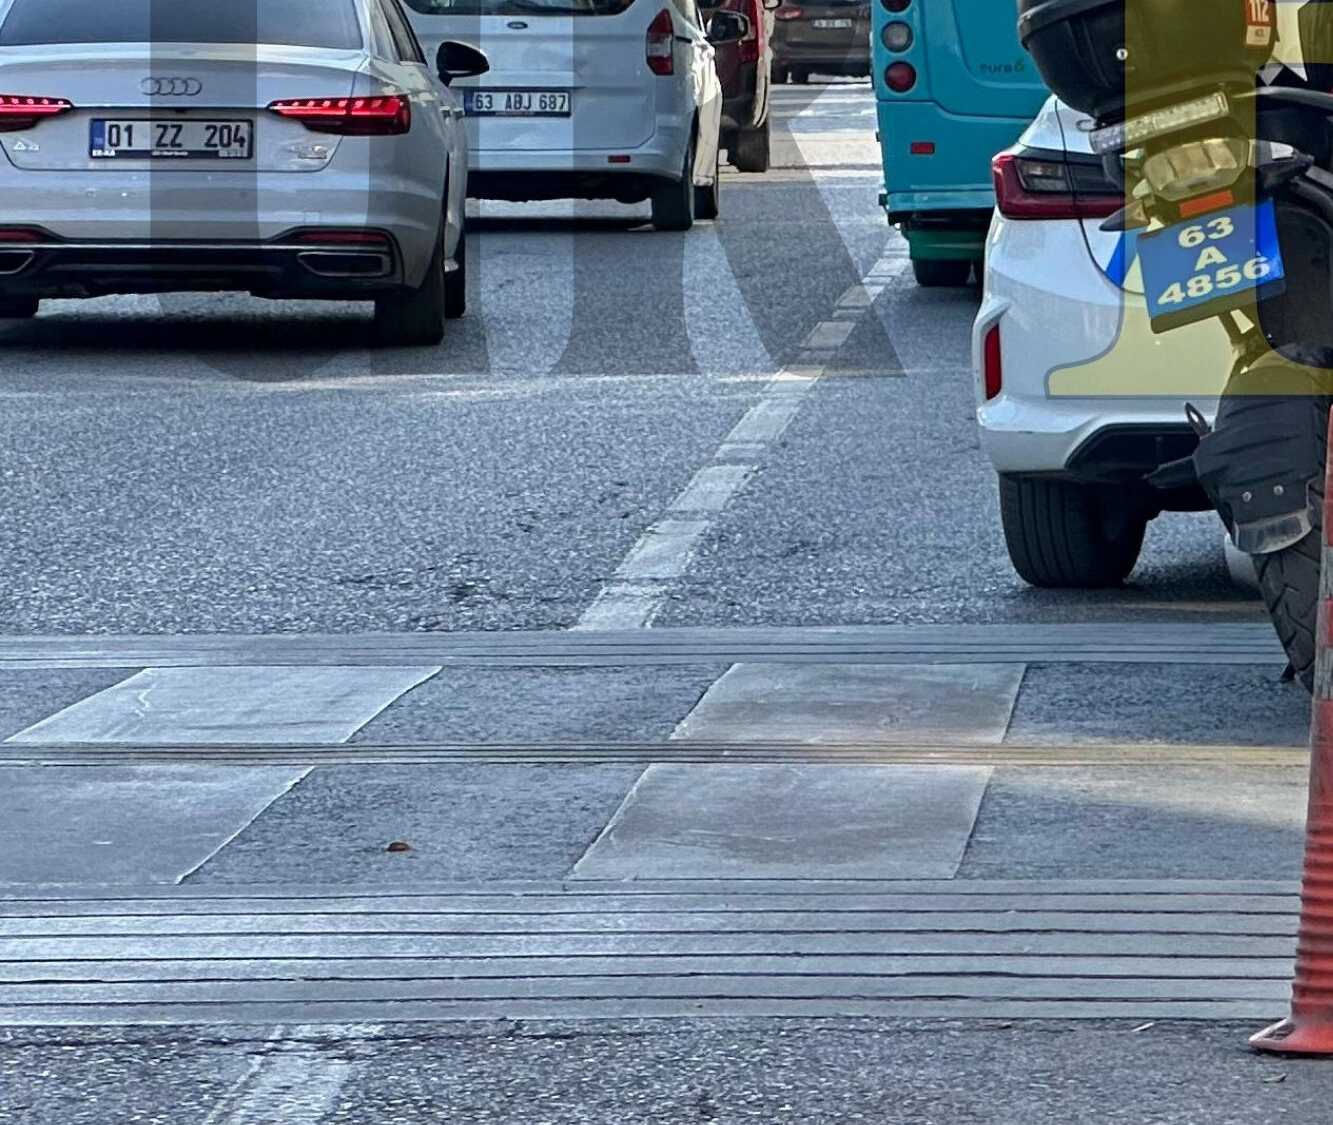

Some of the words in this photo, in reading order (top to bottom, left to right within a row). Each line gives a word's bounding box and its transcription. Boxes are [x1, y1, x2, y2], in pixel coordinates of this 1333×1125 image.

[475, 94, 493, 110] 63
[505, 94, 532, 110] ABJ
[539, 94, 566, 110] 687
[108, 124, 133, 148] 01
[155, 124, 183, 148] ZZ
[205, 124, 247, 148] 204
[1178, 216, 1234, 248] 63
[1194, 246, 1228, 271] A
[1157, 257, 1271, 305] 4856
